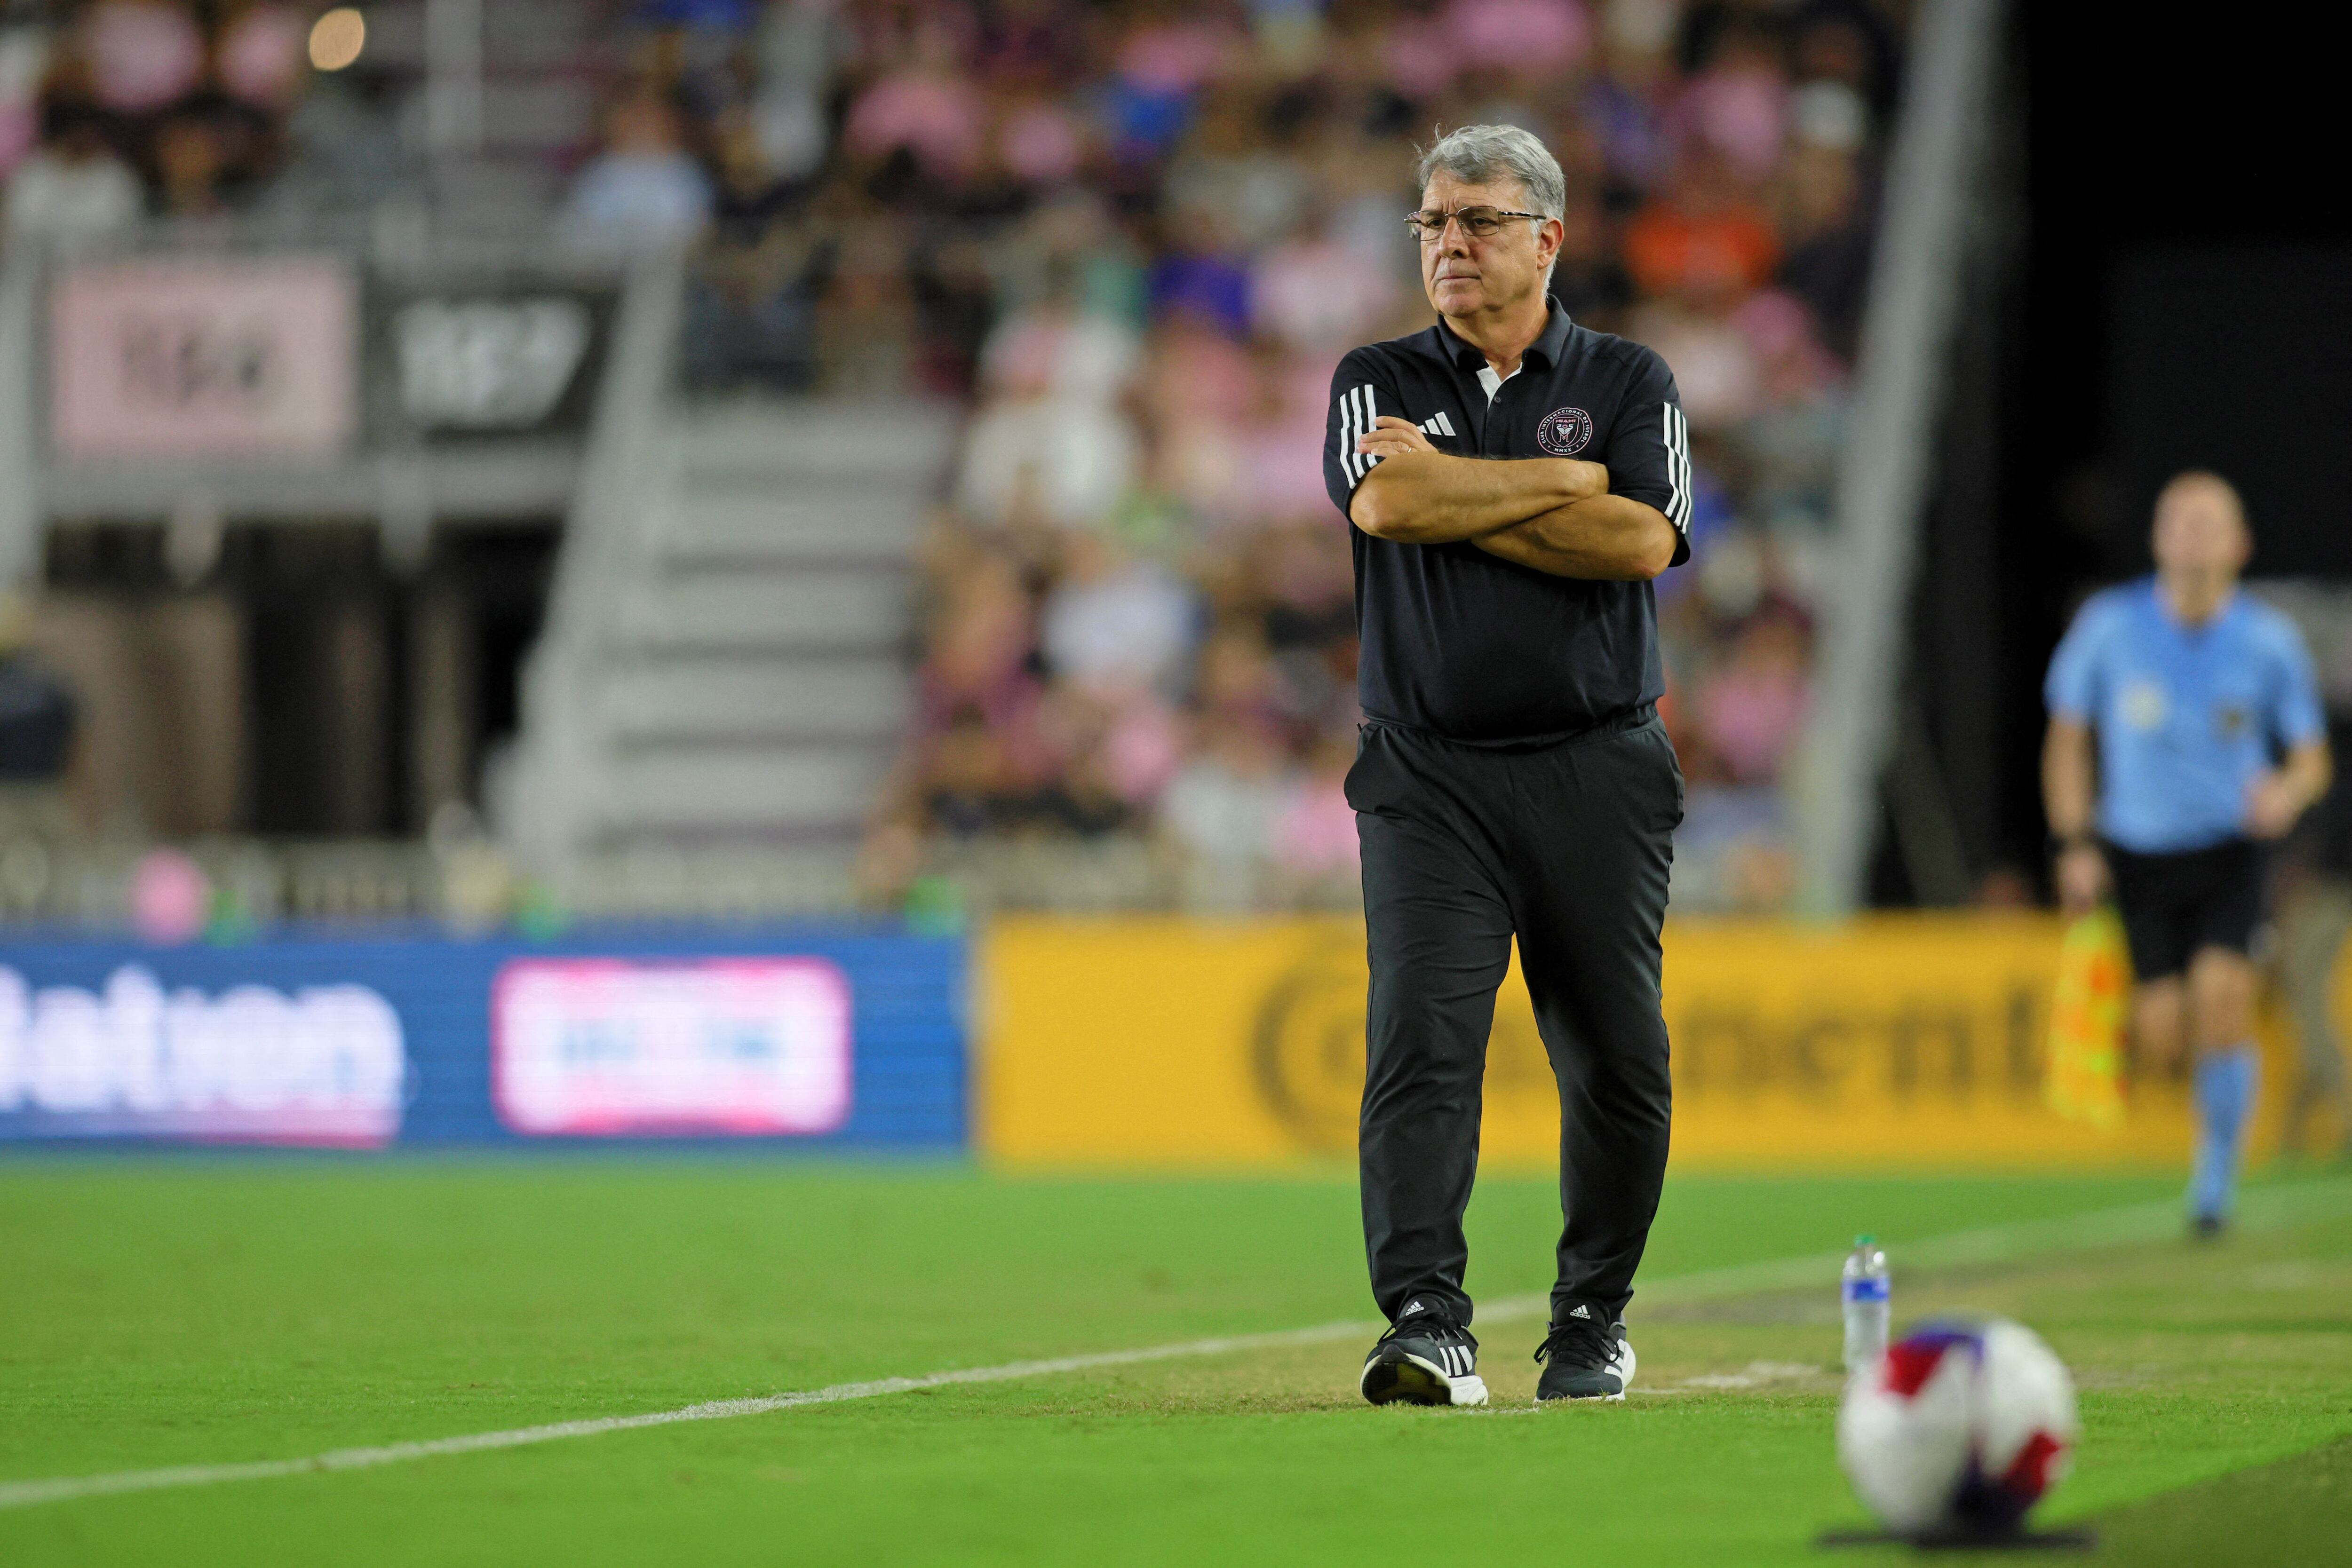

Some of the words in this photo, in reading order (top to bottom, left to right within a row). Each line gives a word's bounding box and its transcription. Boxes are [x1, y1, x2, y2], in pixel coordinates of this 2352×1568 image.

[1541, 410, 1583, 429] INTERNACIONAL
[1405, 1306, 1424, 1316] adidas
[1570, 1311, 1591, 1320] adidas
